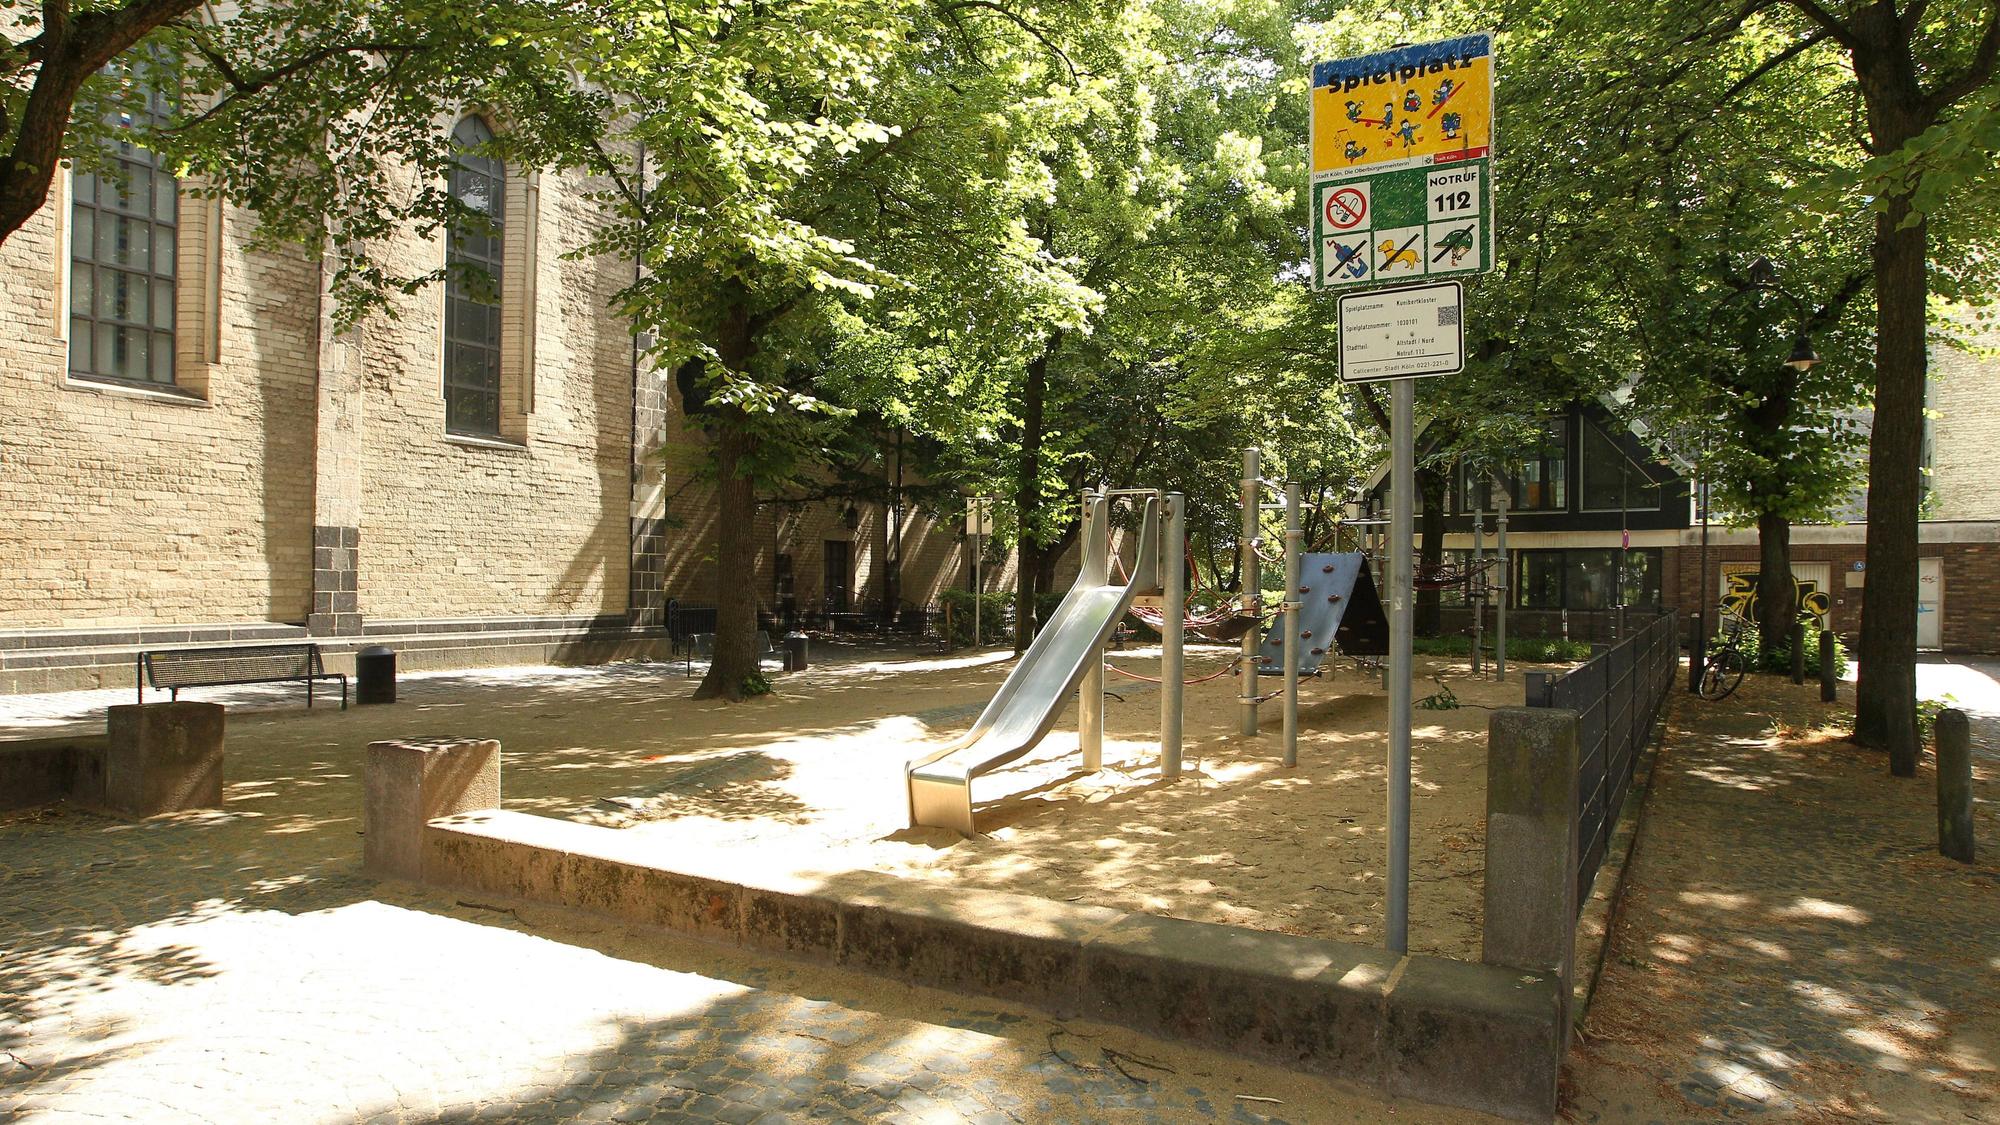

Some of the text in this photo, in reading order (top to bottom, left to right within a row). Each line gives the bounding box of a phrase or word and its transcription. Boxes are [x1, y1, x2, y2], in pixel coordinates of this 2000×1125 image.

[1328, 53, 1473, 94] Spielplatz
[1354, 161, 1410, 173] Oberbürgermeisterin
[1429, 172, 1477, 187] NOTRUF
[1434, 190, 1472, 213] 112
[1384, 364, 1400, 372] Stadt
[1401, 362, 1415, 370] Köln
